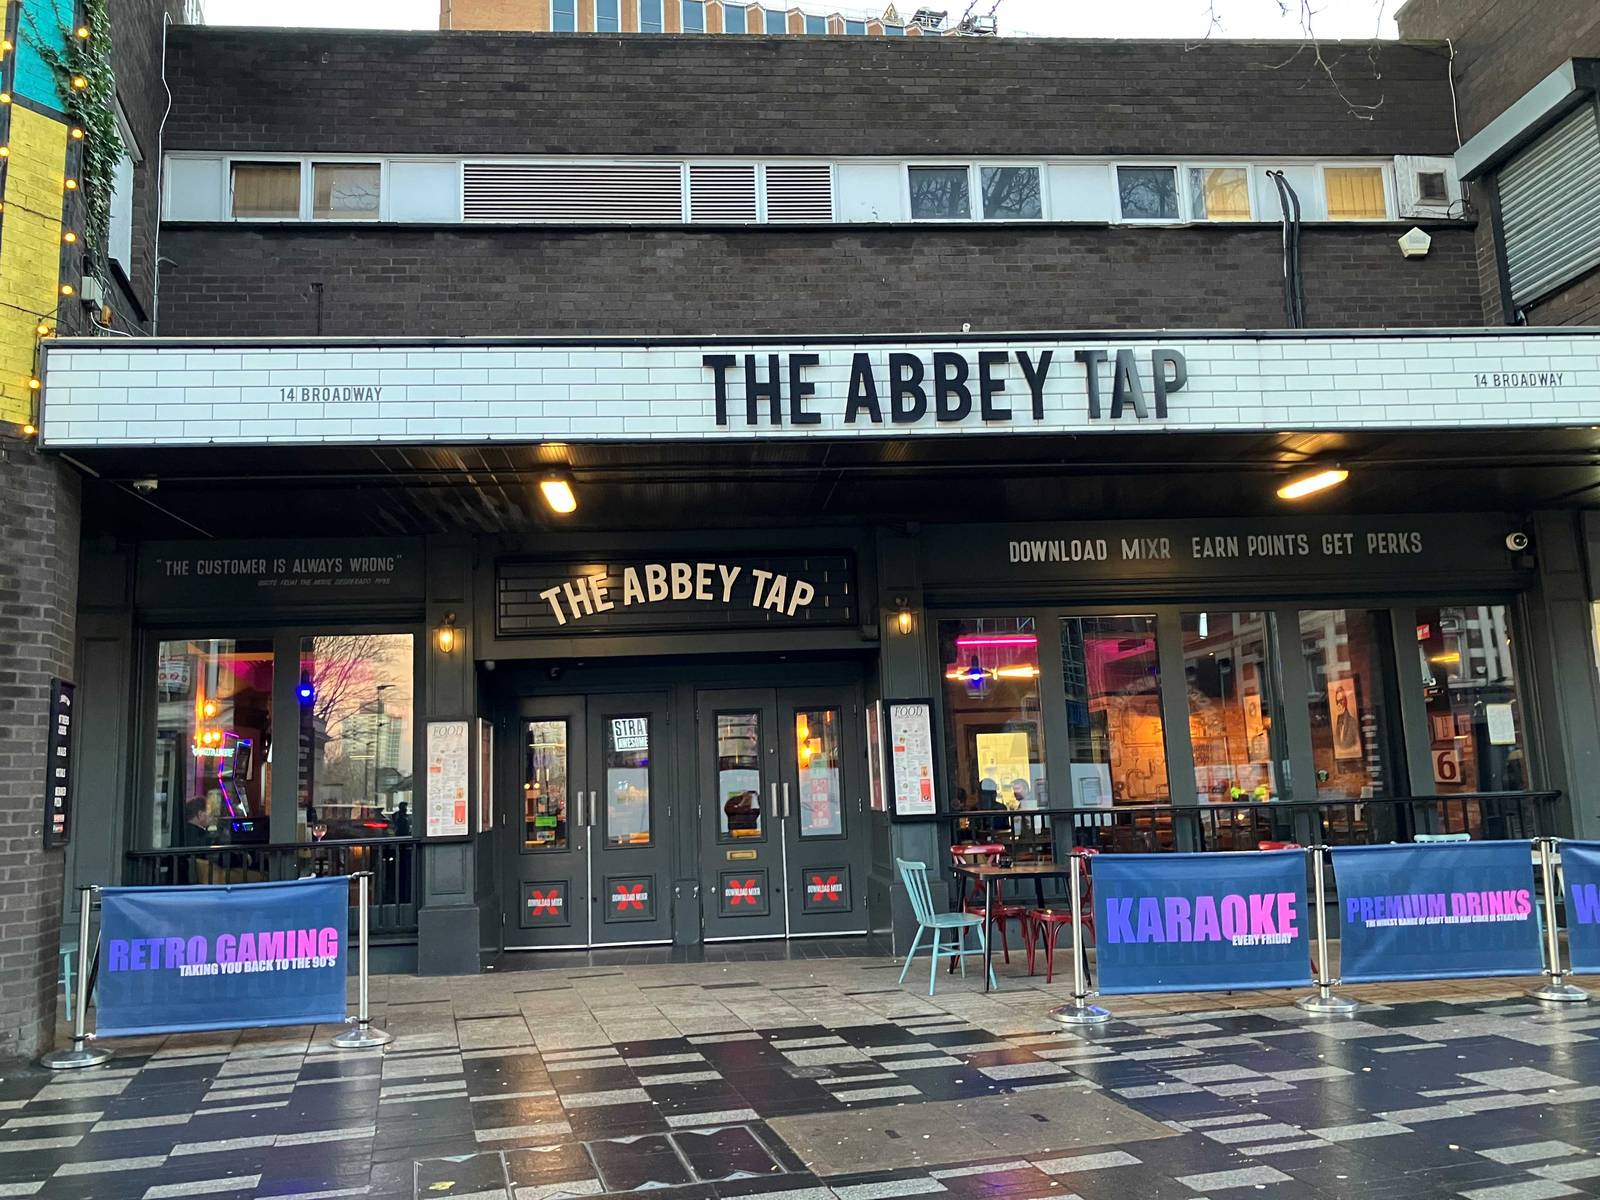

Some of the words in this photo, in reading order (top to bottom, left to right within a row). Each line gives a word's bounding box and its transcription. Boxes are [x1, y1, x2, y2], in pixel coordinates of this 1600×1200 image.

[703, 354, 822, 425] THE
[844, 350, 1054, 423] ABBEY
[1074, 349, 1187, 419] TAP
[1474, 374, 1488, 387] 14
[1493, 373, 1563, 387] BROADWAY
[280, 388, 295, 402] 14
[301, 387, 382, 402] BROADWAY
[1009, 539, 1108, 563] DOWNLOAD
[1121, 538, 1171, 560] MIXR
[1191, 537, 1239, 558] EARN
[1248, 534, 1309, 557] POINTS
[1322, 533, 1354, 556] GET
[1367, 532, 1423, 554] PERKS
[197, 558, 266, 575] CUSTOMER
[273, 558, 286, 574] IS
[293, 557, 343, 573] ALWAYS
[540, 571, 614, 626] THE
[623, 562, 741, 606] ABBEY
[752, 569, 815, 617] TAP
[894, 705, 923, 717] FOOD
[433, 725, 463, 737] FOOD
[1437, 751, 1457, 780] 6
[1106, 892, 1298, 943] KARAOKE
[1347, 893, 1446, 922] PREMIUM
[1451, 889, 1532, 916] DRINKS
[109, 935, 207, 972] RETRO
[216, 927, 338, 965] GAMING
[1232, 934, 1261, 946] EVERY
[1262, 932, 1292, 945] FRIDAY
[179, 963, 218, 977] TAKING
[220, 963, 242, 974] YOU
[244, 959, 273, 972] BACK
[275, 958, 288, 970] TO
[291, 957, 312, 970] THE
[312, 955, 336, 968] 90'S
